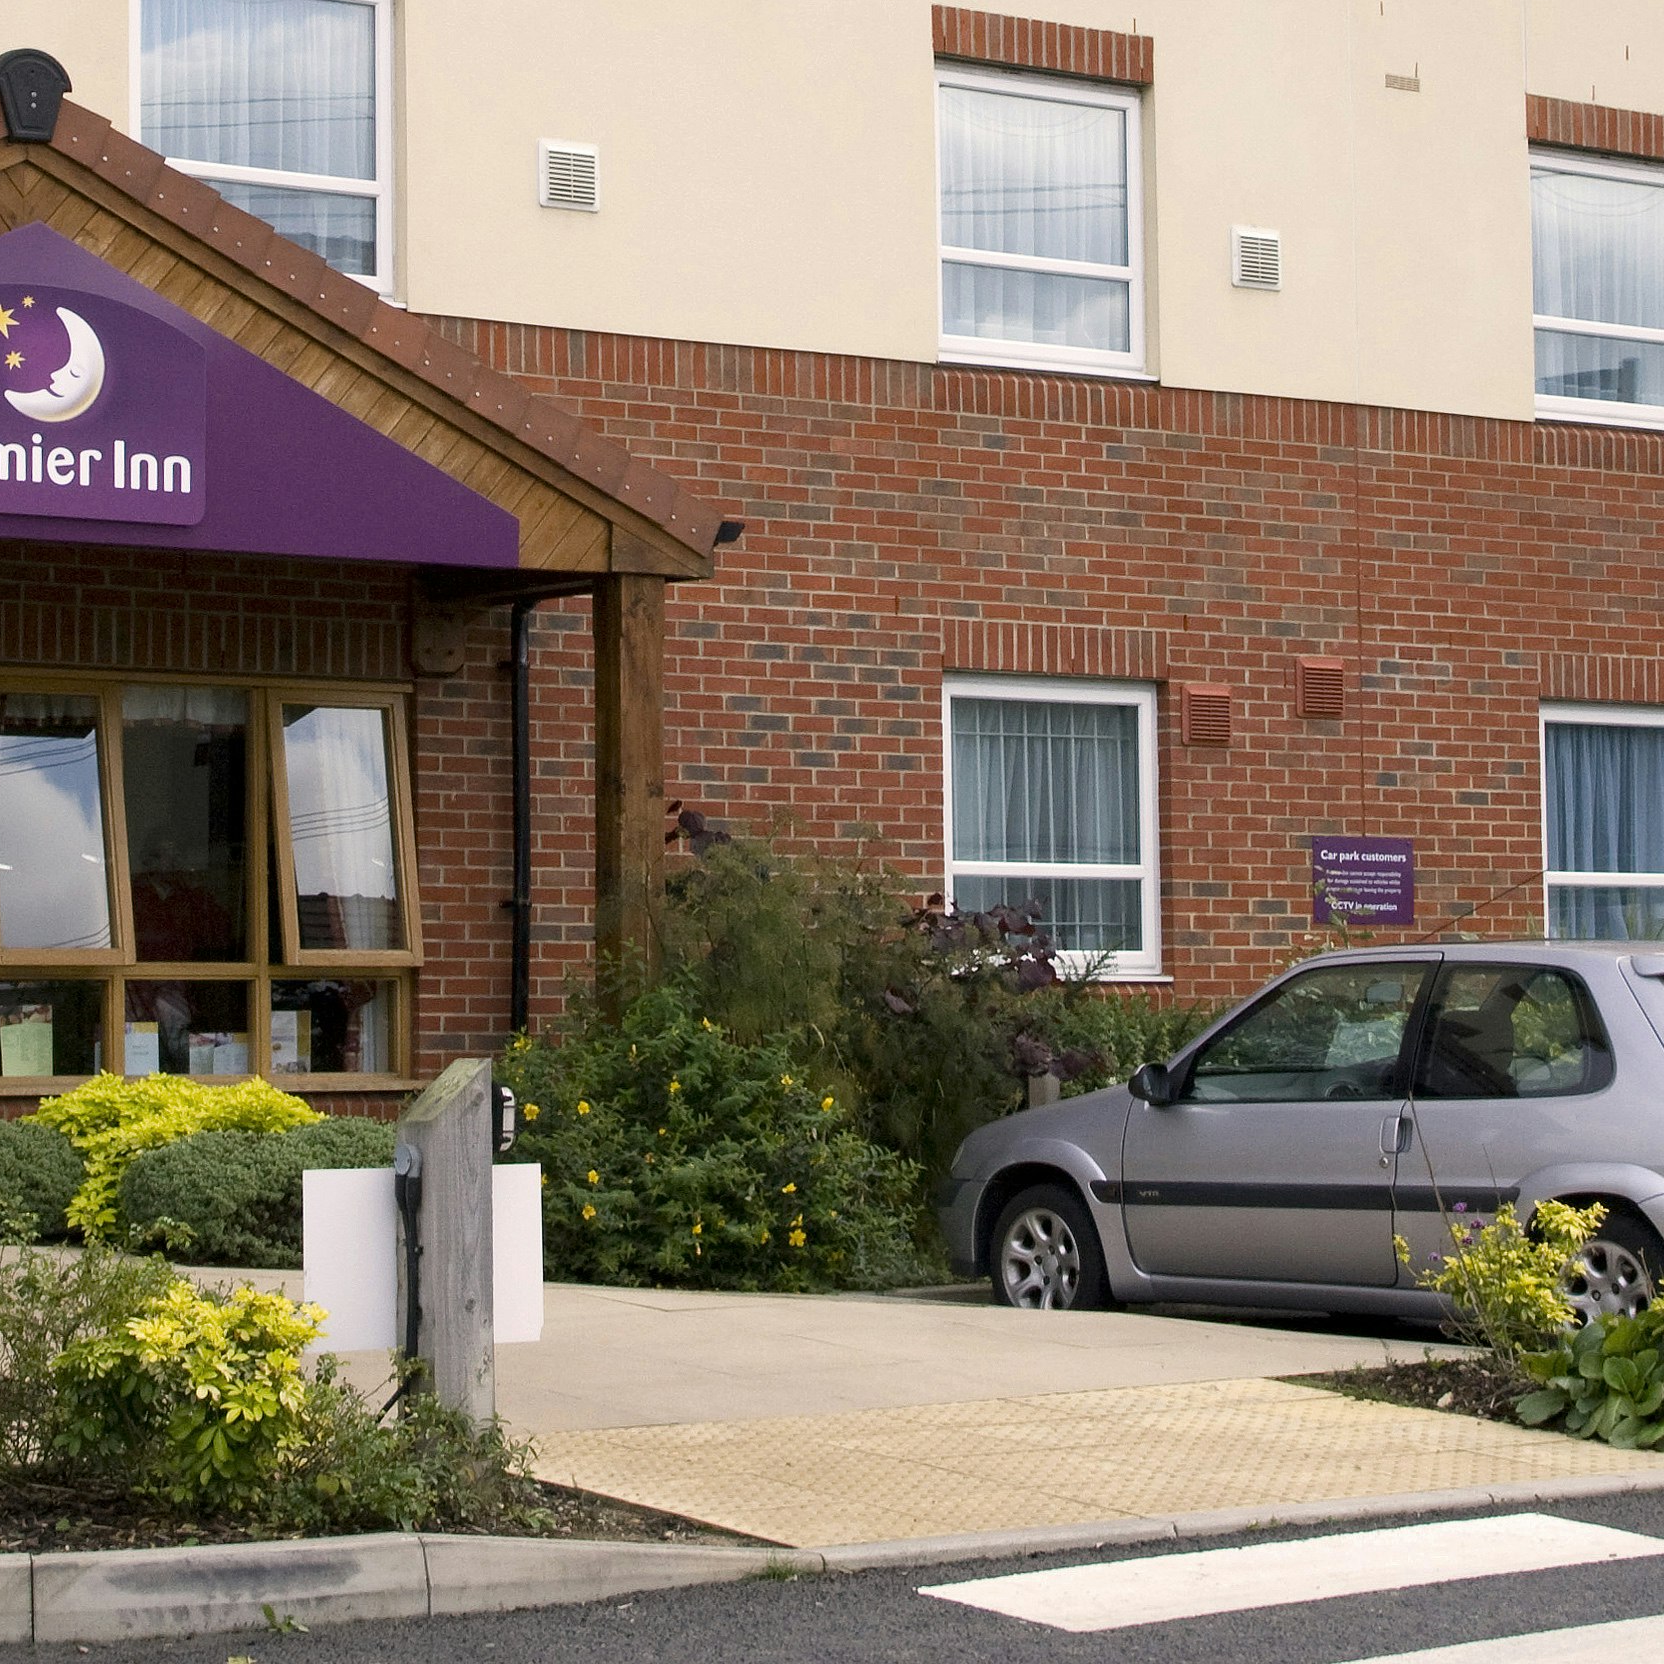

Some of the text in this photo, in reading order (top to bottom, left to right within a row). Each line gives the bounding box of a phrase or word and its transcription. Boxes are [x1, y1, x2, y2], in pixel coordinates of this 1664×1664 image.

[113, 439, 191, 494] Inn
[1320, 849, 1407, 863] Car park customers
